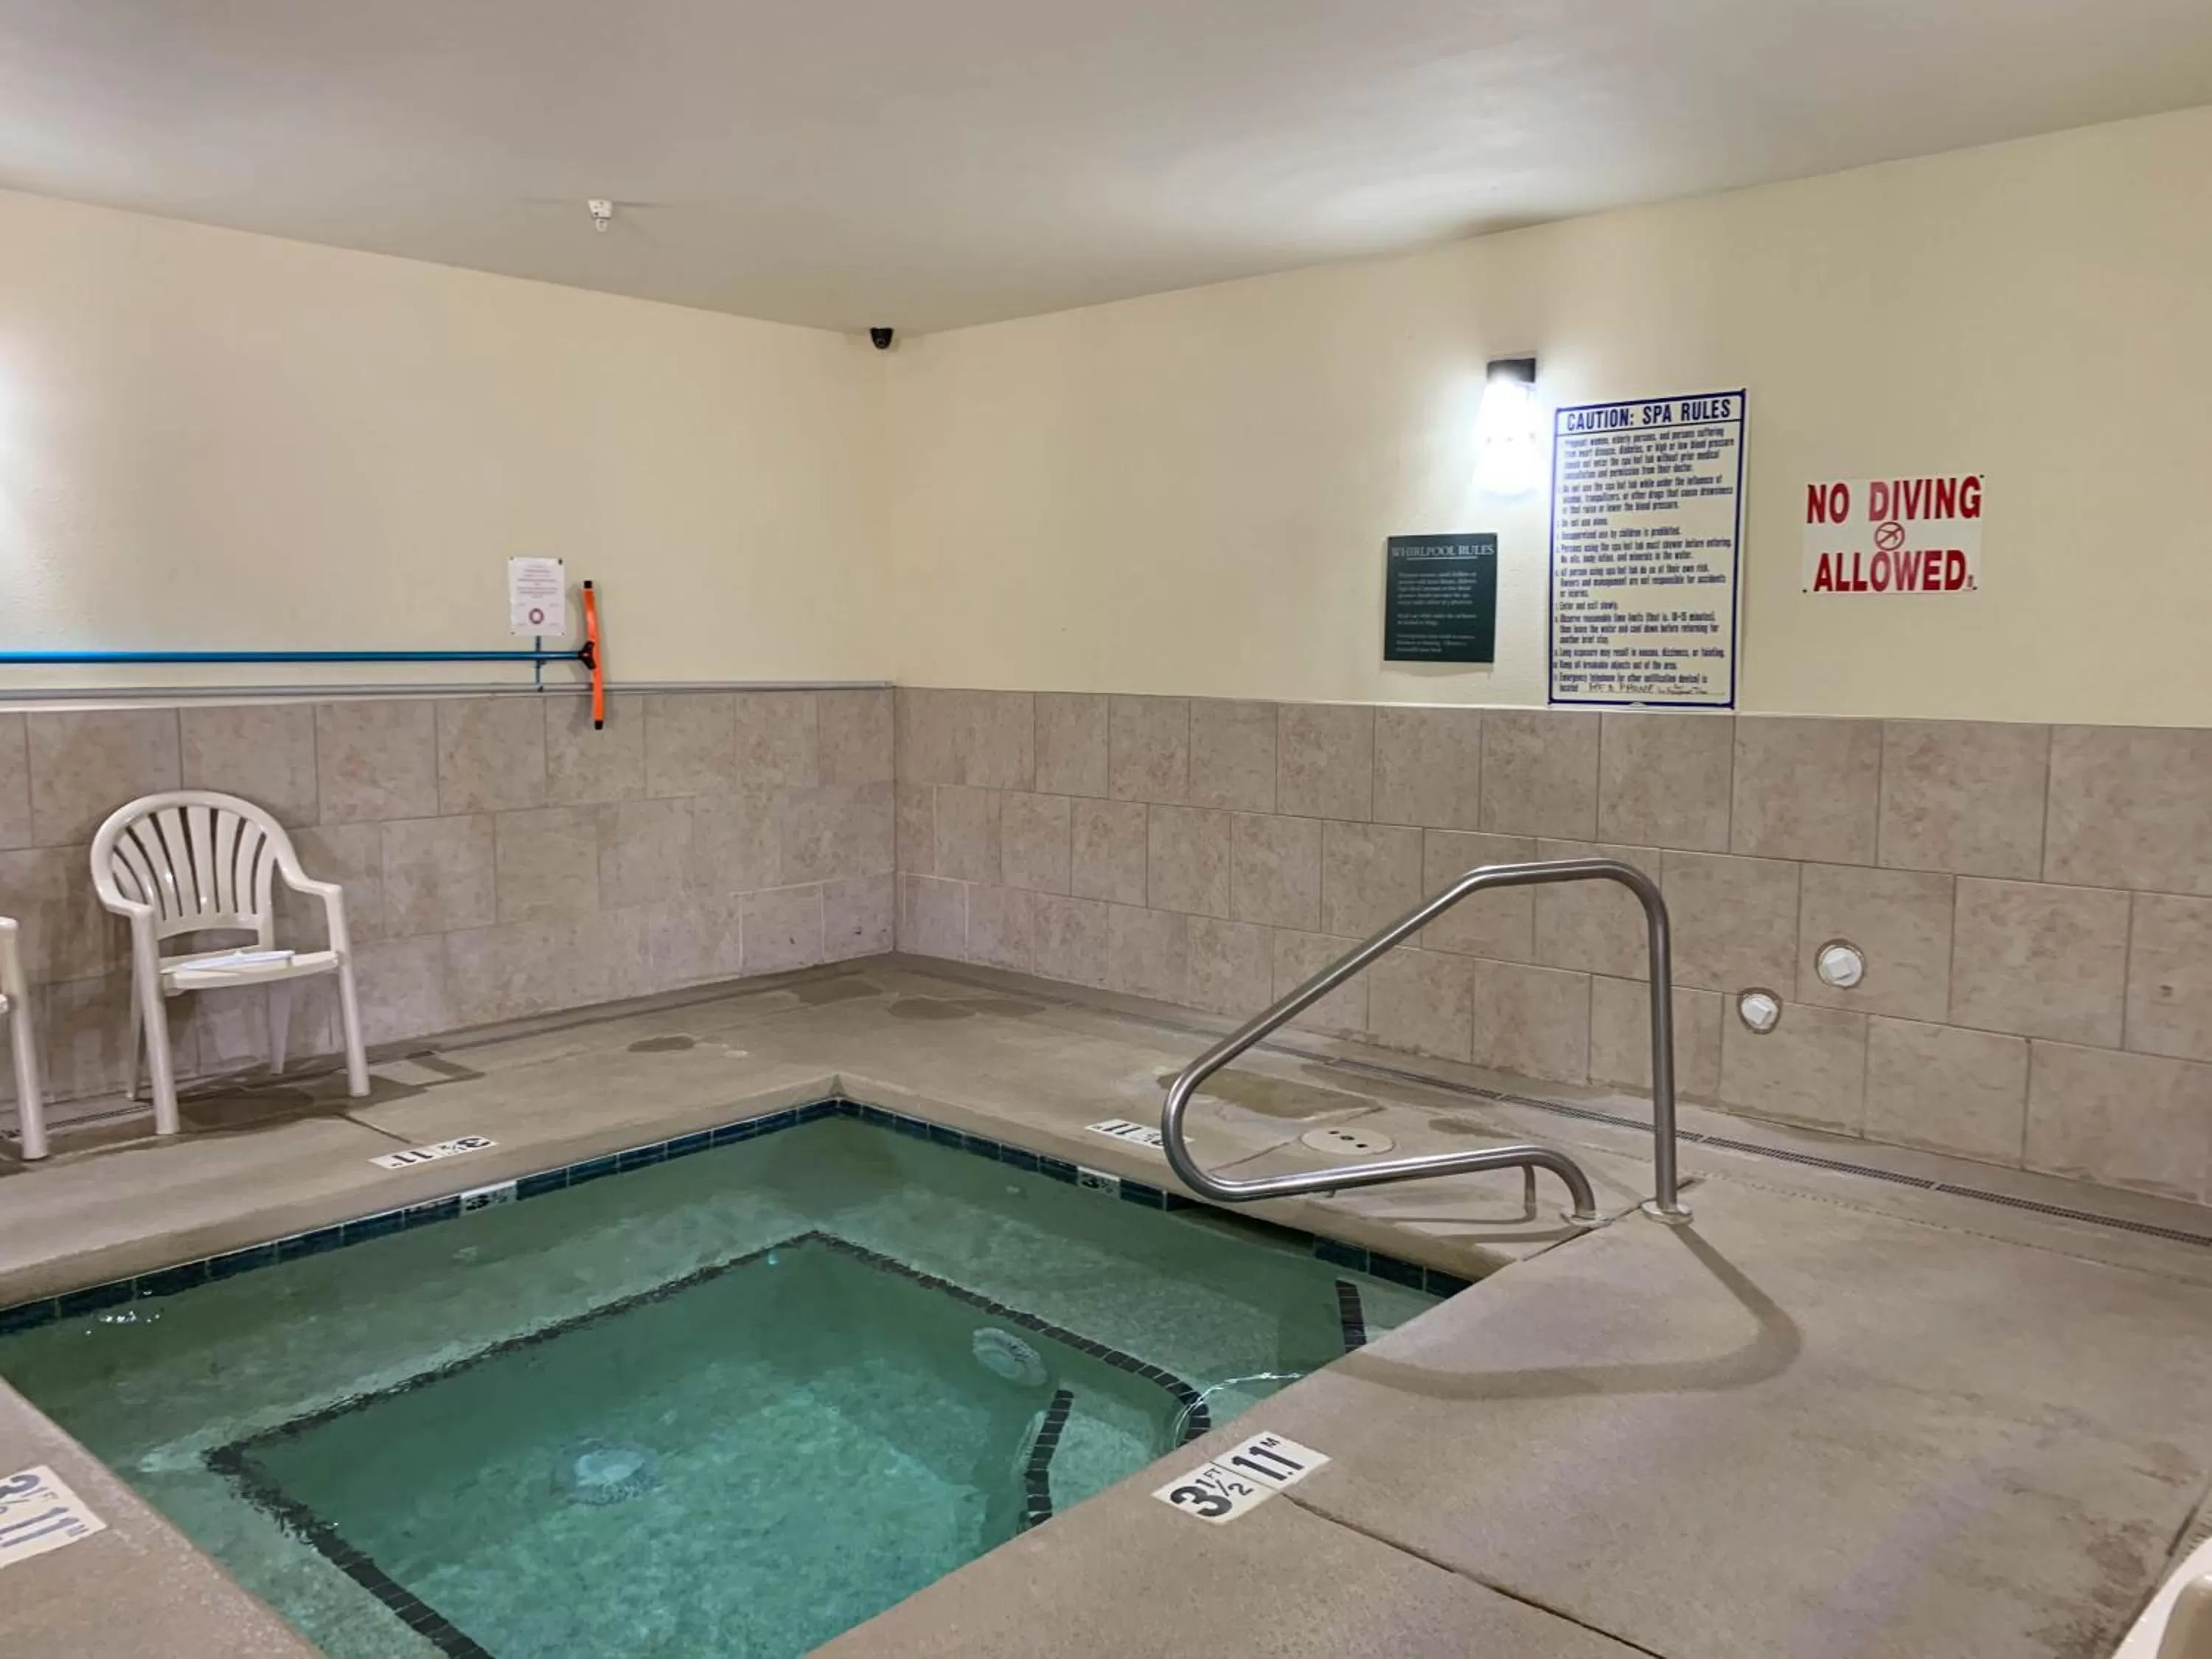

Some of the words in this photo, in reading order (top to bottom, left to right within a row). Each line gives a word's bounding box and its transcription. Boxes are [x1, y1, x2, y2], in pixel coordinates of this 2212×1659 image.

[1568, 408, 1634, 431] CAUTION:
[1643, 403, 1672, 425] SPA
[1680, 399, 1731, 421] RULES
[1806, 483, 1849, 524] NO
[1868, 476, 1982, 521] DIVING
[1458, 543, 1495, 555] RULES
[1813, 550, 1966, 592] ALLOWED
